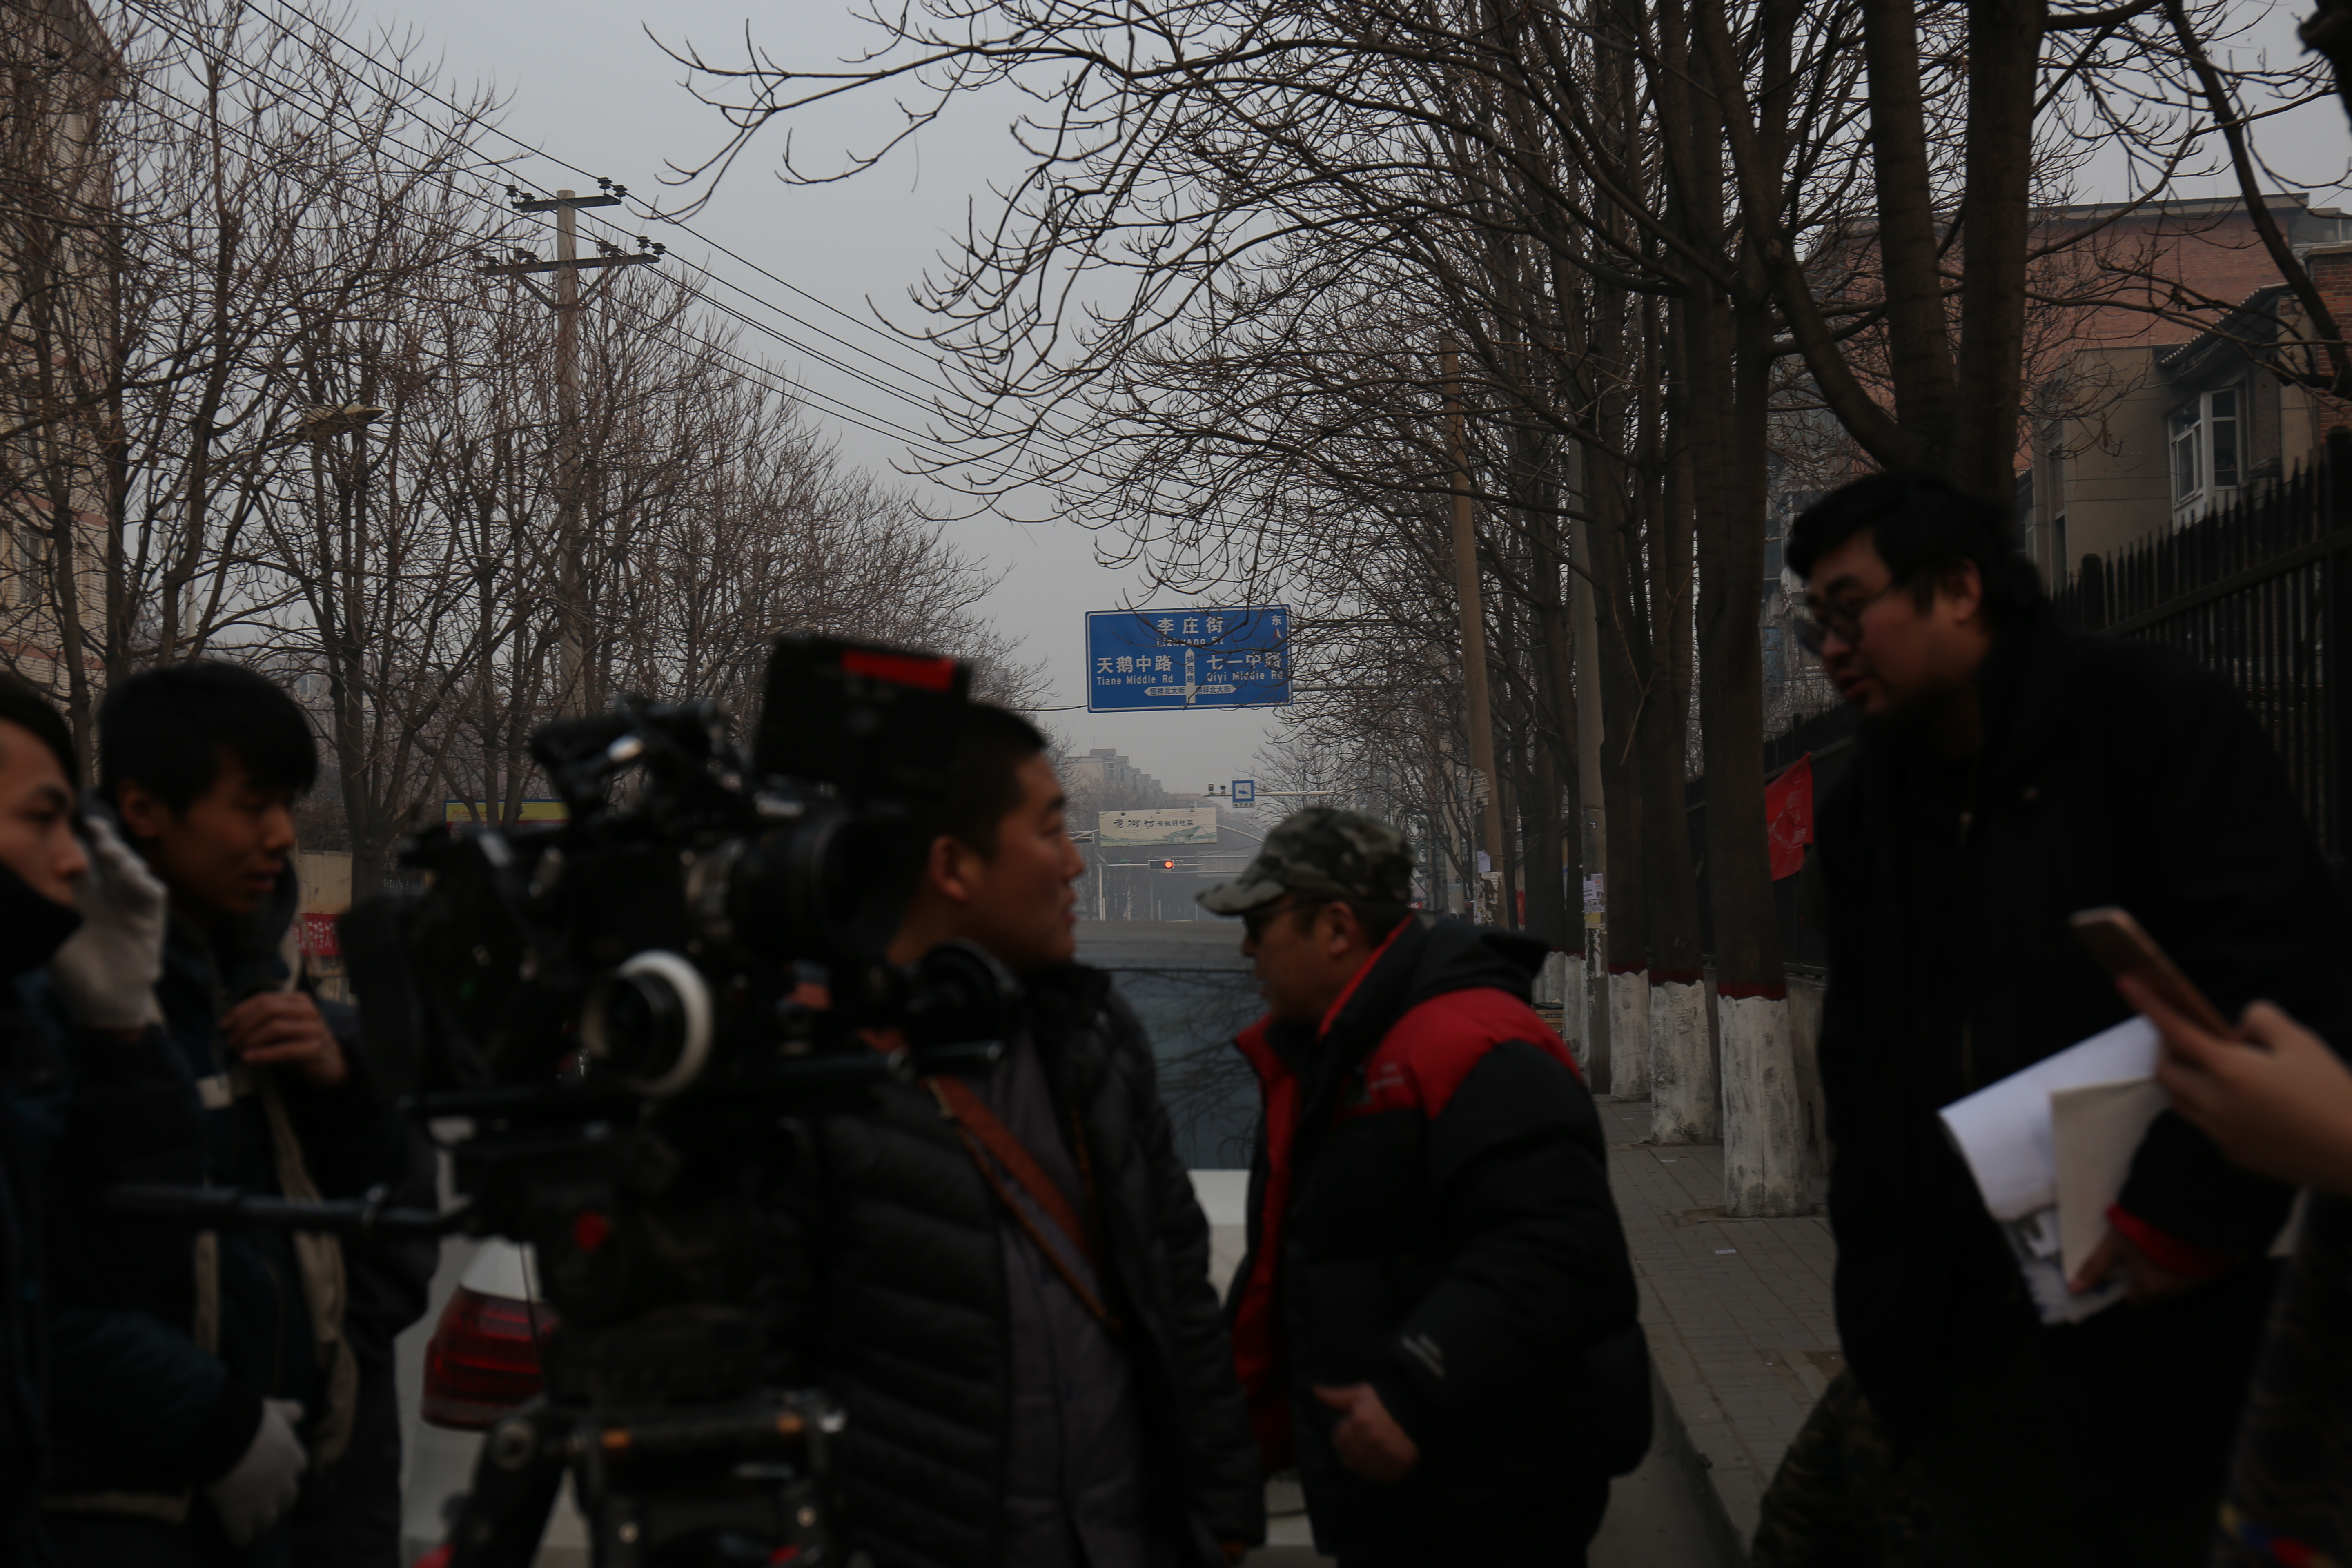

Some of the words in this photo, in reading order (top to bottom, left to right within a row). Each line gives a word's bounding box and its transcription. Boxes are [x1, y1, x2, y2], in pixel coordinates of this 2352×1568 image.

[1157, 617, 1223, 634] 李庄街
[1271, 615, 1282, 626] 东
[1097, 655, 1172, 674] 天鹅中路
[1206, 652, 1281, 670] 七一中路
[1096, 677, 1122, 685] Tiane
[1126, 675, 1156, 684] Middle
[1162, 675, 1173, 683] Rd
[1206, 672, 1227, 683] Qiyi
[1232, 671, 1265, 681] Middle
[1271, 670, 1283, 679] Rd
[1150, 687, 1185, 695] 恒祥北大街
